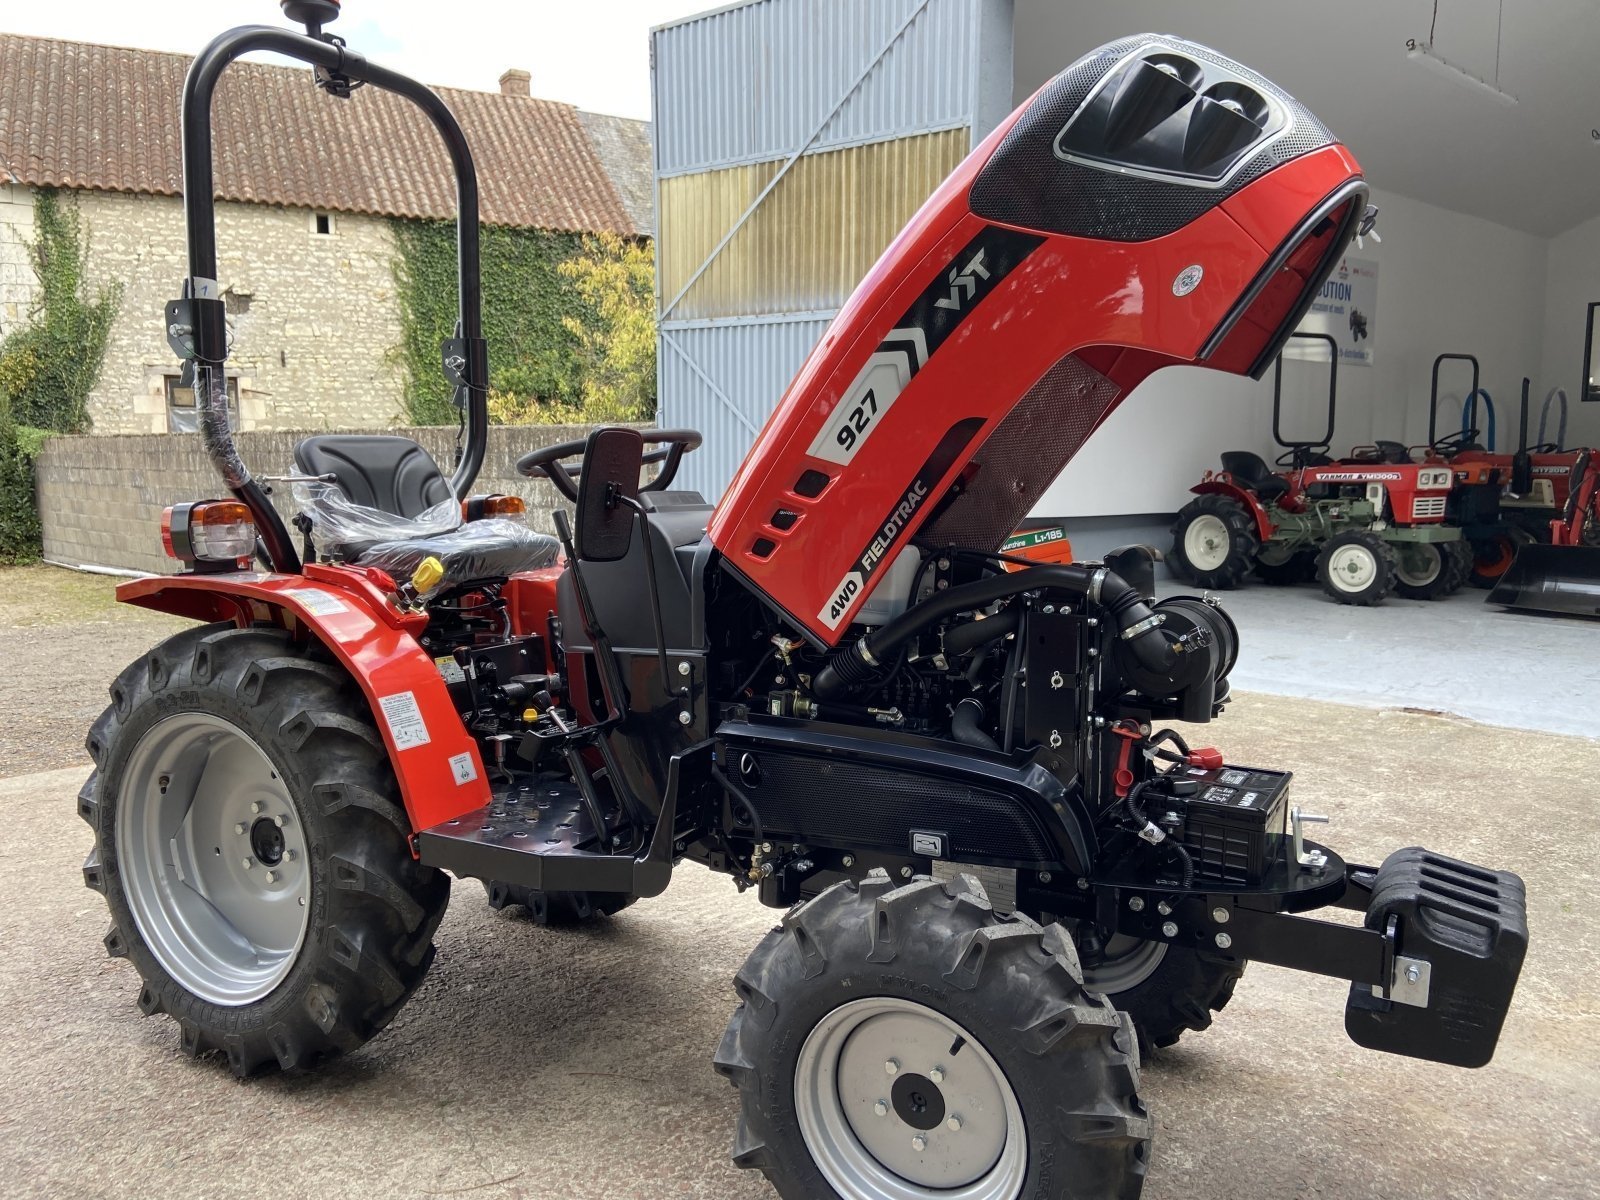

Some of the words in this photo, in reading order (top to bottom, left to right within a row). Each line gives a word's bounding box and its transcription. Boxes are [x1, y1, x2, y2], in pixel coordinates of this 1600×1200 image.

[934, 246, 991, 310] VST
[836, 387, 878, 453] 927
[861, 480, 928, 571] FIELDTRAC
[829, 579, 858, 621] 4WD
